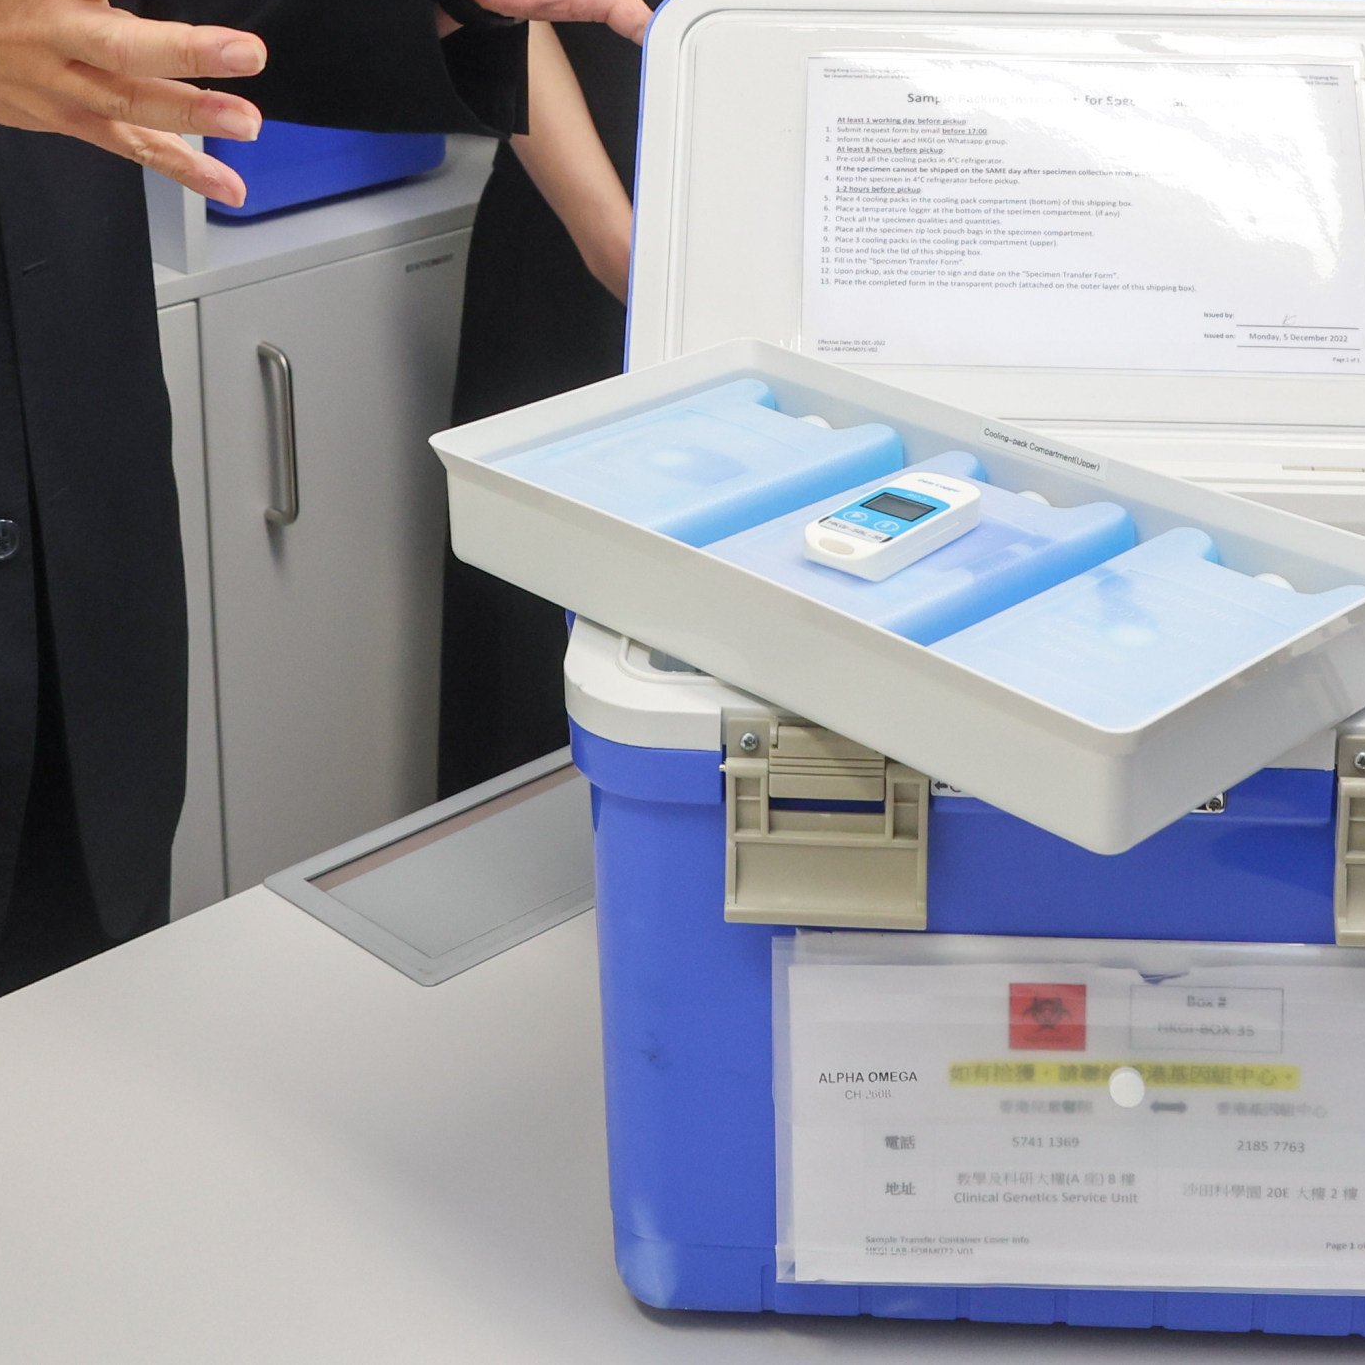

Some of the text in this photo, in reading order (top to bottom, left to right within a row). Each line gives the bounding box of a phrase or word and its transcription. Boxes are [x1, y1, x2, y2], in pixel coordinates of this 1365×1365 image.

[846, 117, 865, 125] least
[871, 117, 902, 126] working
[916, 117, 941, 125] before
[846, 145, 865, 154] least
[871, 146, 893, 154] hours
[893, 146, 918, 154] before
[856, 165, 892, 175] specimen
[892, 166, 919, 174] cannot
[930, 166, 960, 176] shipped
[1023, 167, 1041, 175] after
[1041, 167, 1077, 177] specimen
[849, 185, 871, 194] hours
[871, 186, 896, 194] before
[835, 215, 858, 223] Check
[881, 216, 917, 225] specimen
[917, 216, 948, 226] qualities
[834, 246, 855, 254] Close
[934, 247, 966, 257] shipping
[910, 269, 938, 277] courier
[1063, 271, 1094, 279] Transfer
[833, 277, 854, 286] Place
[868, 278, 909, 288] completed
[950, 280, 994, 289] transparent
[994, 280, 1019, 290] pouch
[1080, 282, 1101, 290] outer
[1101, 282, 1121, 292] layer
[1145, 283, 1177, 293] shipping
[1249, 333, 1281, 342] Monday,
[1290, 333, 1328, 342] December
[1330, 335, 1348, 343] 2022
[983, 428, 1028, 449] Cooling-pack
[1186, 995, 1212, 1008] Box
[818, 1071, 918, 1084] ALPHA OMEGA
[884, 1135, 916, 1151] 電話
[1011, 1136, 1080, 1148] 5741 1369
[1237, 1140, 1306, 1153] 2185 7763
[885, 1182, 916, 1196] 地址
[1330, 1188, 1337, 1199] 2
[953, 1192, 1139, 1204] Clinical Genetics Service Unit
[865, 1235, 898, 1245] Sample
[900, 1235, 936, 1244] Transfer
[938, 1236, 982, 1244] Container
[1325, 1242, 1348, 1251] Page
